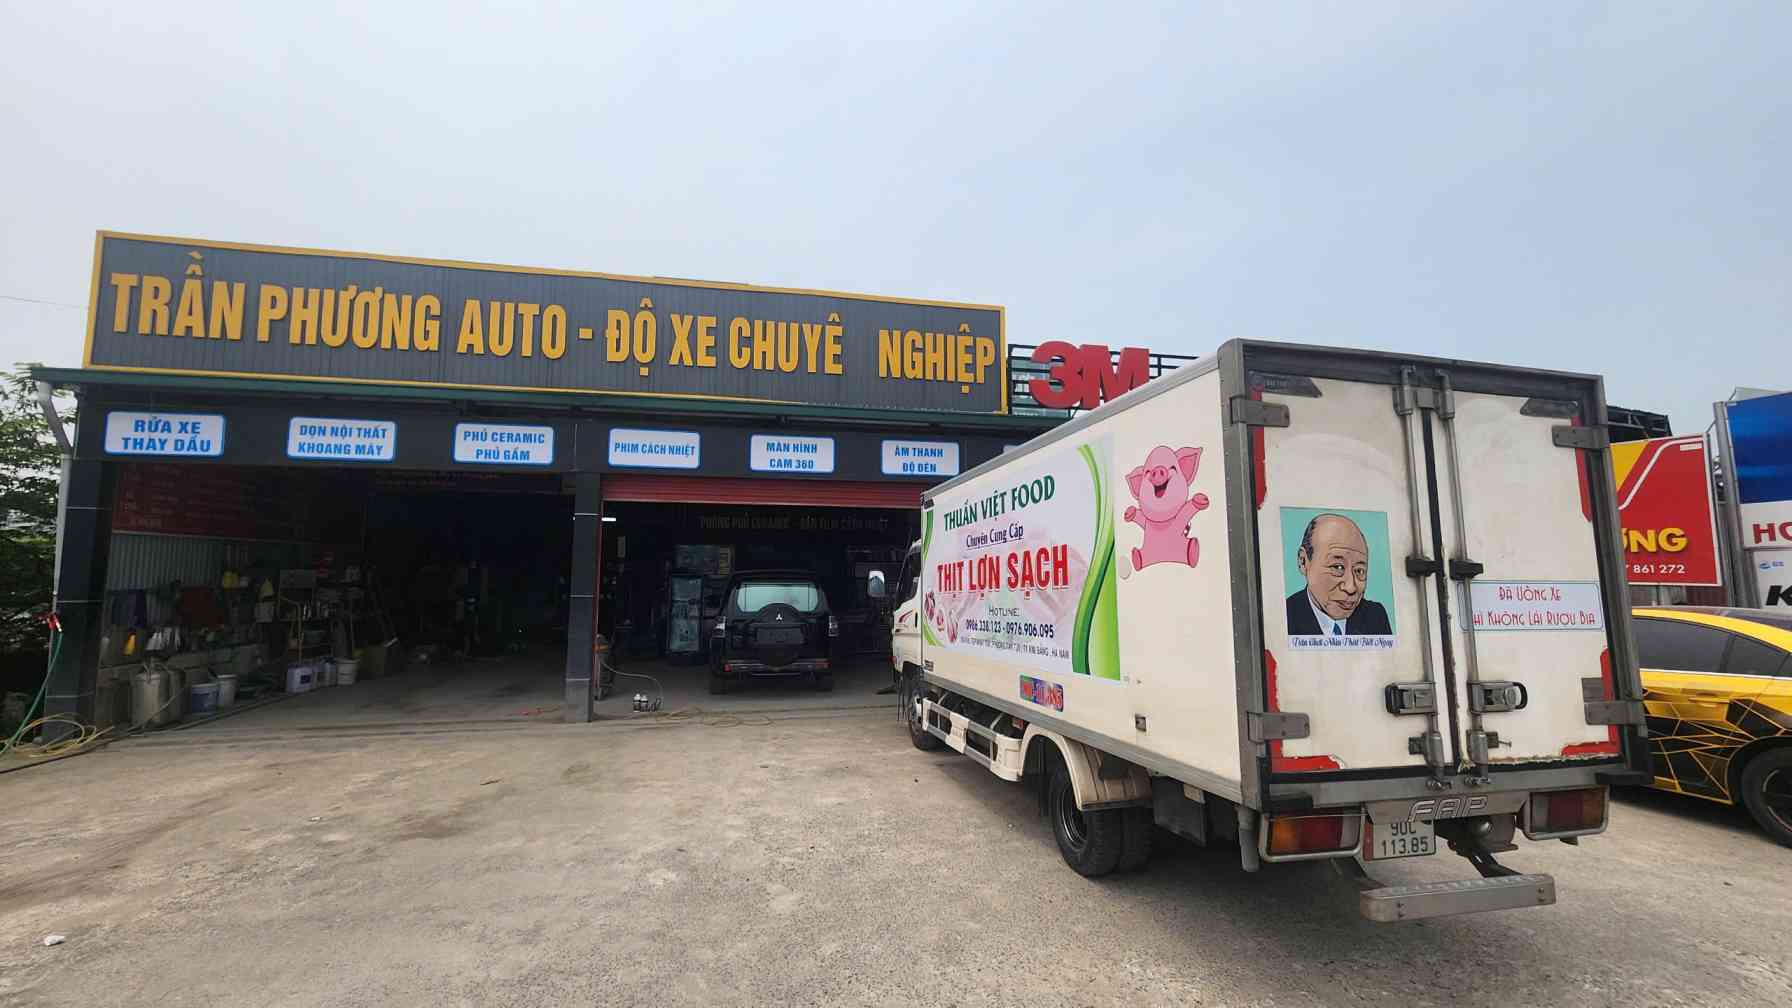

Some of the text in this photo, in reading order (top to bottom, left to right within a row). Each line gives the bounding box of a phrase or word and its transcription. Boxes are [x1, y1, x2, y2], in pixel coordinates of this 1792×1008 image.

[110, 251, 247, 341] TRẦN
[256, 282, 442, 353] PHƯƠNG
[456, 299, 568, 361] AUTO
[605, 297, 657, 377] ĐỘ
[668, 312, 718, 369] XE
[728, 312, 845, 376] CHUYÊ
[878, 323, 996, 394] NGHIỆP
[1028, 340, 1150, 411] 3M
[134, 416, 202, 434] RỬA XE
[330, 424, 353, 440] NỘI
[121, 436, 169, 451] THAY
[463, 428, 545, 445] PHỦ CERAMIC
[297, 441, 352, 456] KHOANG
[475, 446, 500, 460] PHỦ
[614, 442, 640, 454] PHIM
[668, 443, 696, 458] NHIỆT
[894, 445, 944, 458] ÂM THANH
[769, 458, 814, 470] CAM 360
[980, 490, 1008, 521] VIỆT
[1010, 474, 1056, 512] FOOD
[989, 527, 1007, 544] Cung
[1008, 521, 1024, 540] Cấp
[937, 543, 1070, 600] THỊT LỢN SẠCH
[1633, 563, 1655, 574] 861
[1659, 564, 1686, 574] 272
[1550, 586, 1561, 601] XE
[1580, 610, 1596, 625] BIA
[1381, 836, 1429, 856] 113.85
